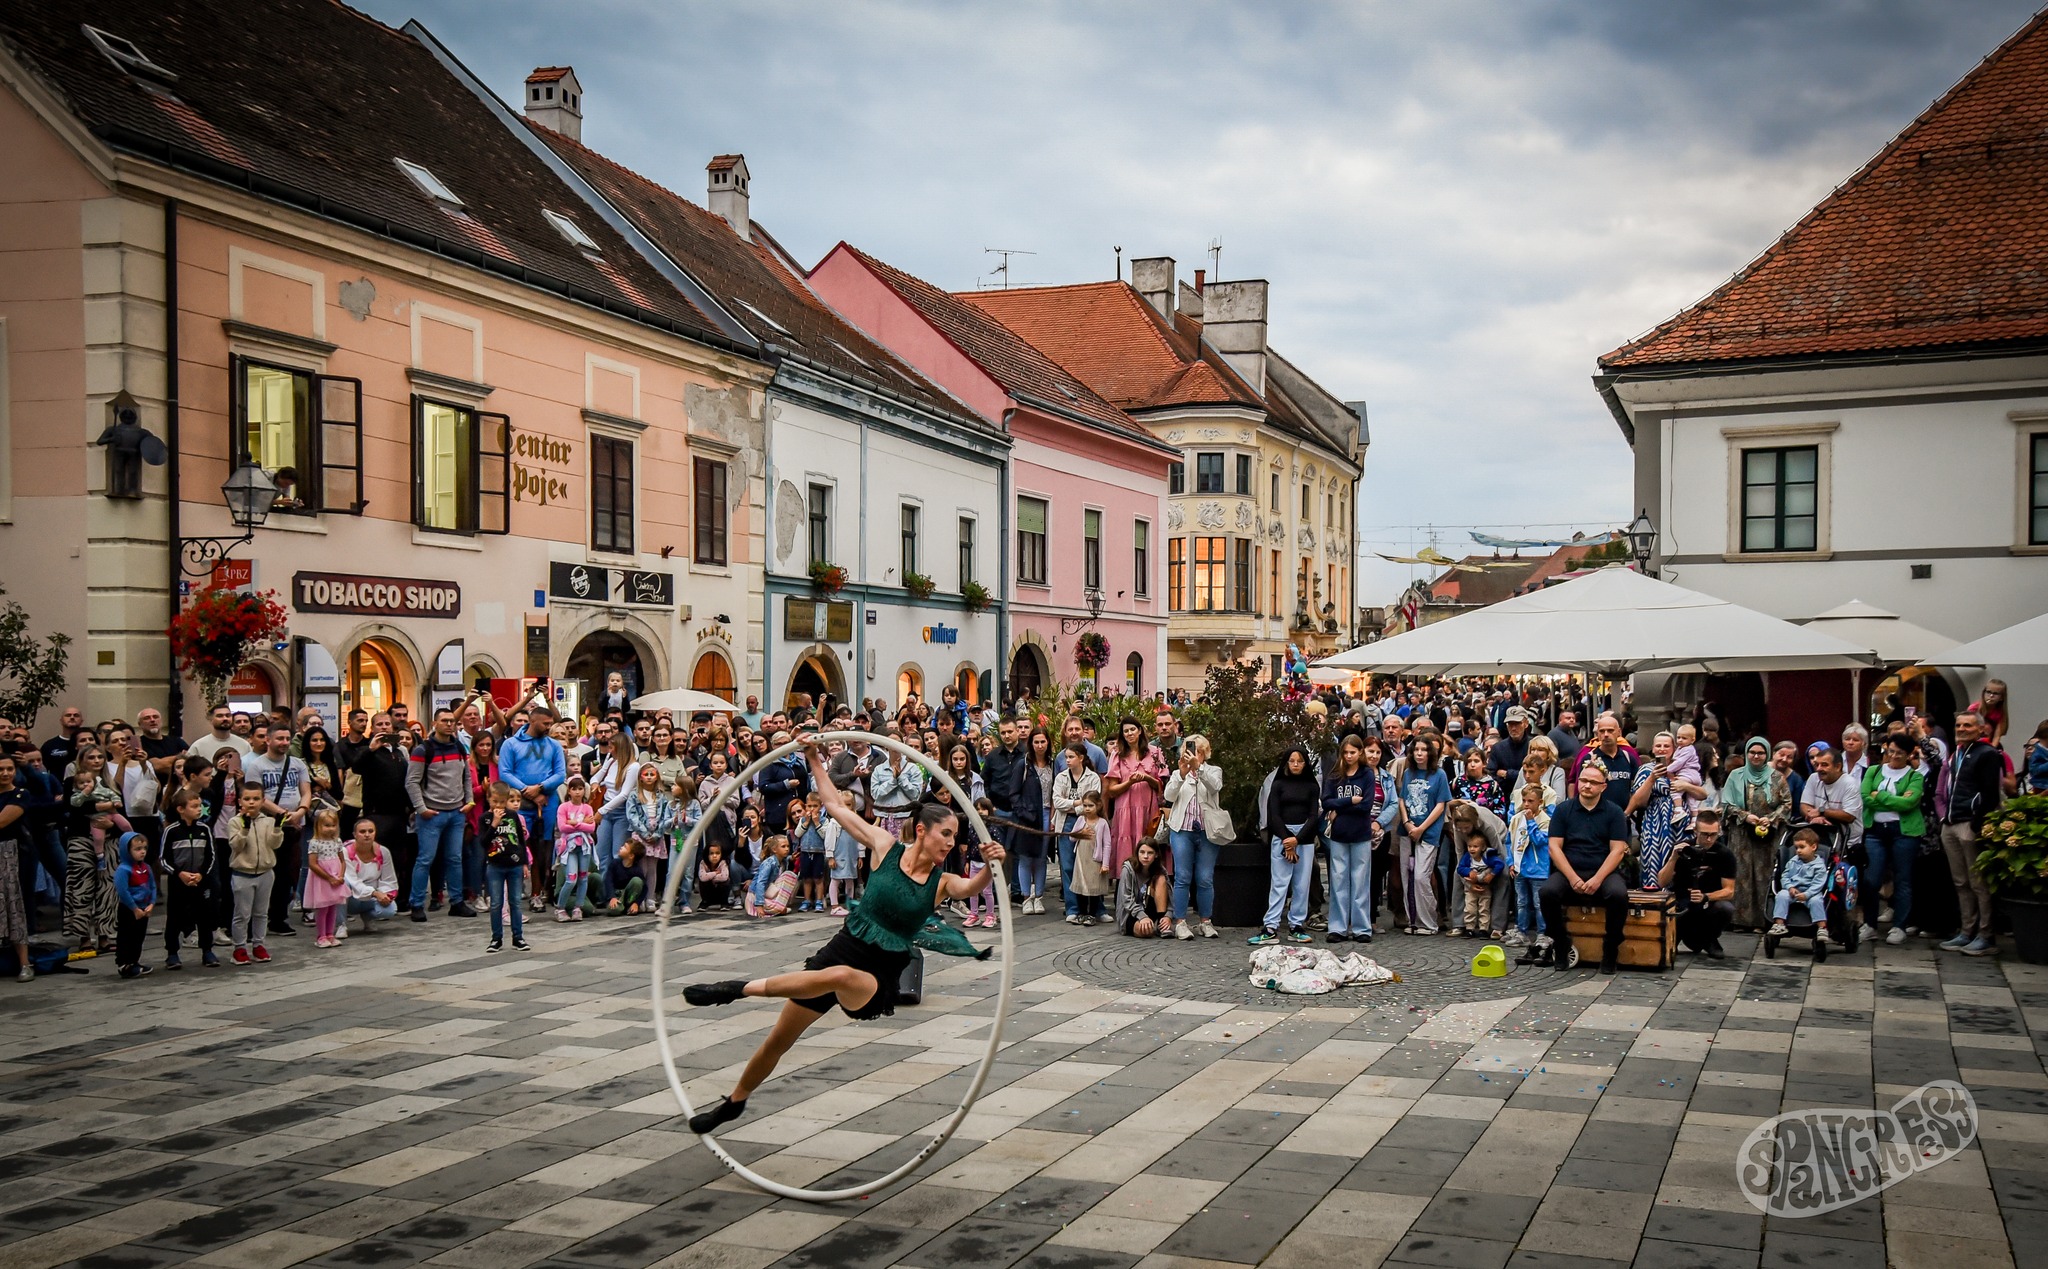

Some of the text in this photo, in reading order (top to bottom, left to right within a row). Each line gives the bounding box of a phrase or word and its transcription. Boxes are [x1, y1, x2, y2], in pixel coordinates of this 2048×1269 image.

[230, 569, 248, 580] PBZ
[300, 579, 458, 611] TOBACCO SHOP
[697, 624, 732, 645] ZLATAR
[930, 622, 958, 645] mlinar
